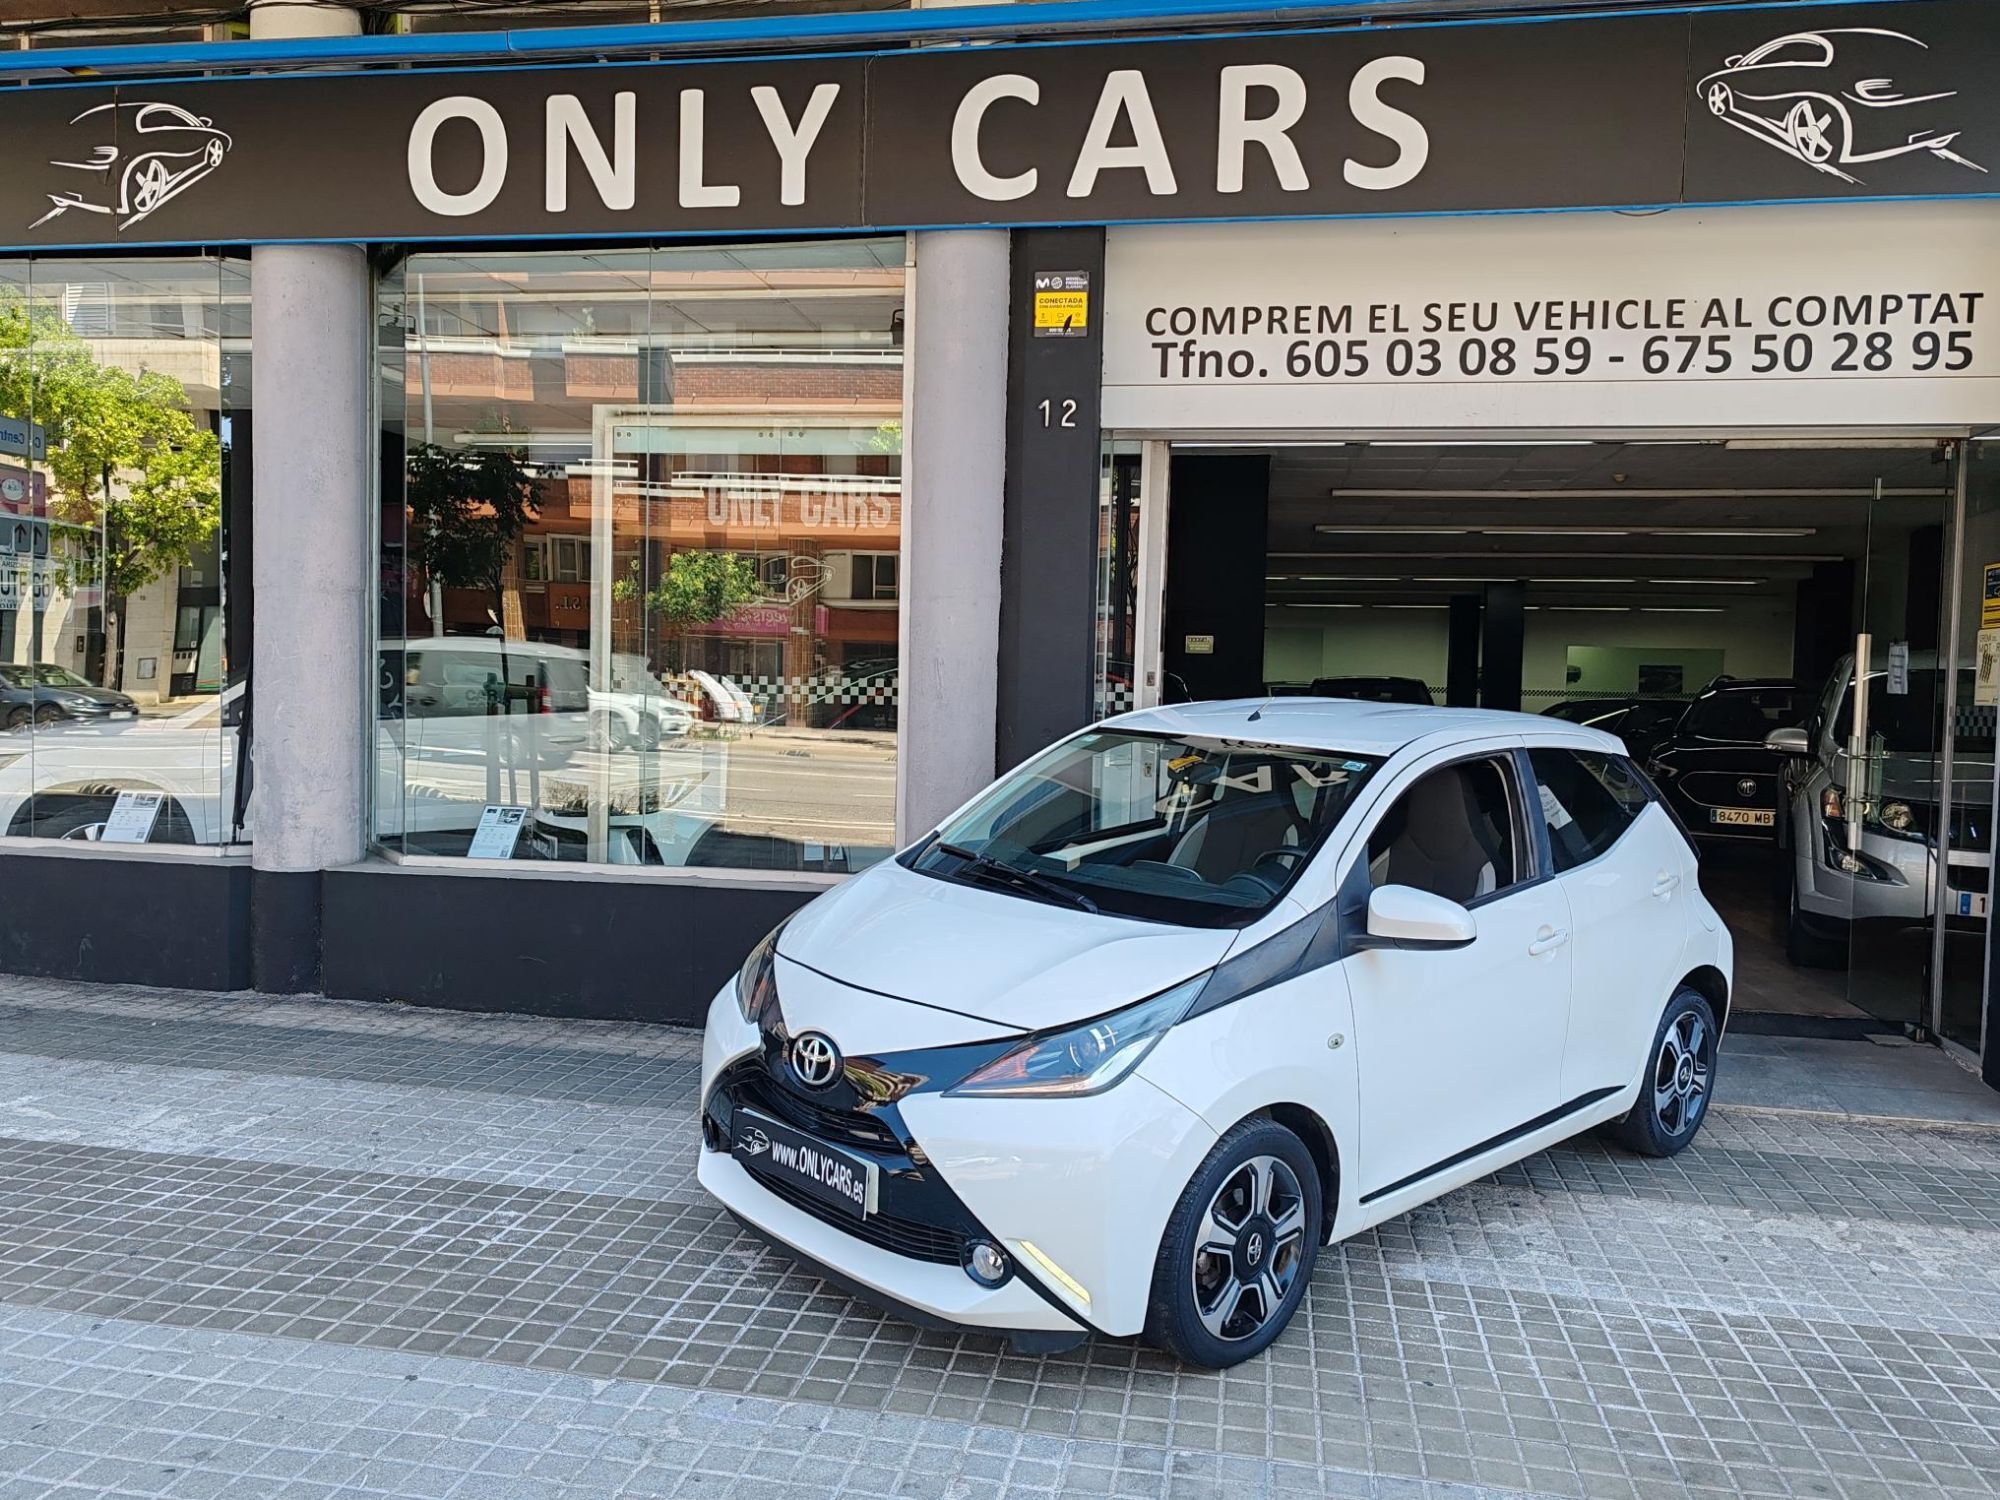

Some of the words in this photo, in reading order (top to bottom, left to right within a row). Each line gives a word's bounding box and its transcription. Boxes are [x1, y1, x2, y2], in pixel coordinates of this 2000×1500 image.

[407, 83, 841, 217] ONLY
[951, 55, 1429, 202] CARS
[1145, 304, 1352, 337] COMPREM
[1369, 304, 1409, 334] EL
[1422, 302, 1498, 333] SEU
[1514, 299, 1686, 332] VEHICLE
[1700, 298, 1752, 329] AL
[1768, 292, 1984, 328] COMPTAT
[1151, 340, 1268, 379] Tfno.
[1286, 340, 1369, 378] 605
[1386, 339, 1442, 378] 03
[1459, 338, 1516, 377] 08
[1534, 337, 1591, 376] 59
[1642, 335, 1732, 375] 675
[1751, 333, 1813, 374] 50
[1831, 332, 1892, 373] 28
[1912, 330, 1973, 372] 95
[1039, 399, 1077, 428] 12
[707, 475, 785, 527] ONLY
[800, 480, 892, 529] CARS
[1718, 811, 1749, 823] 8470
[771, 1140, 865, 1205] www.ONLYCARS.es
